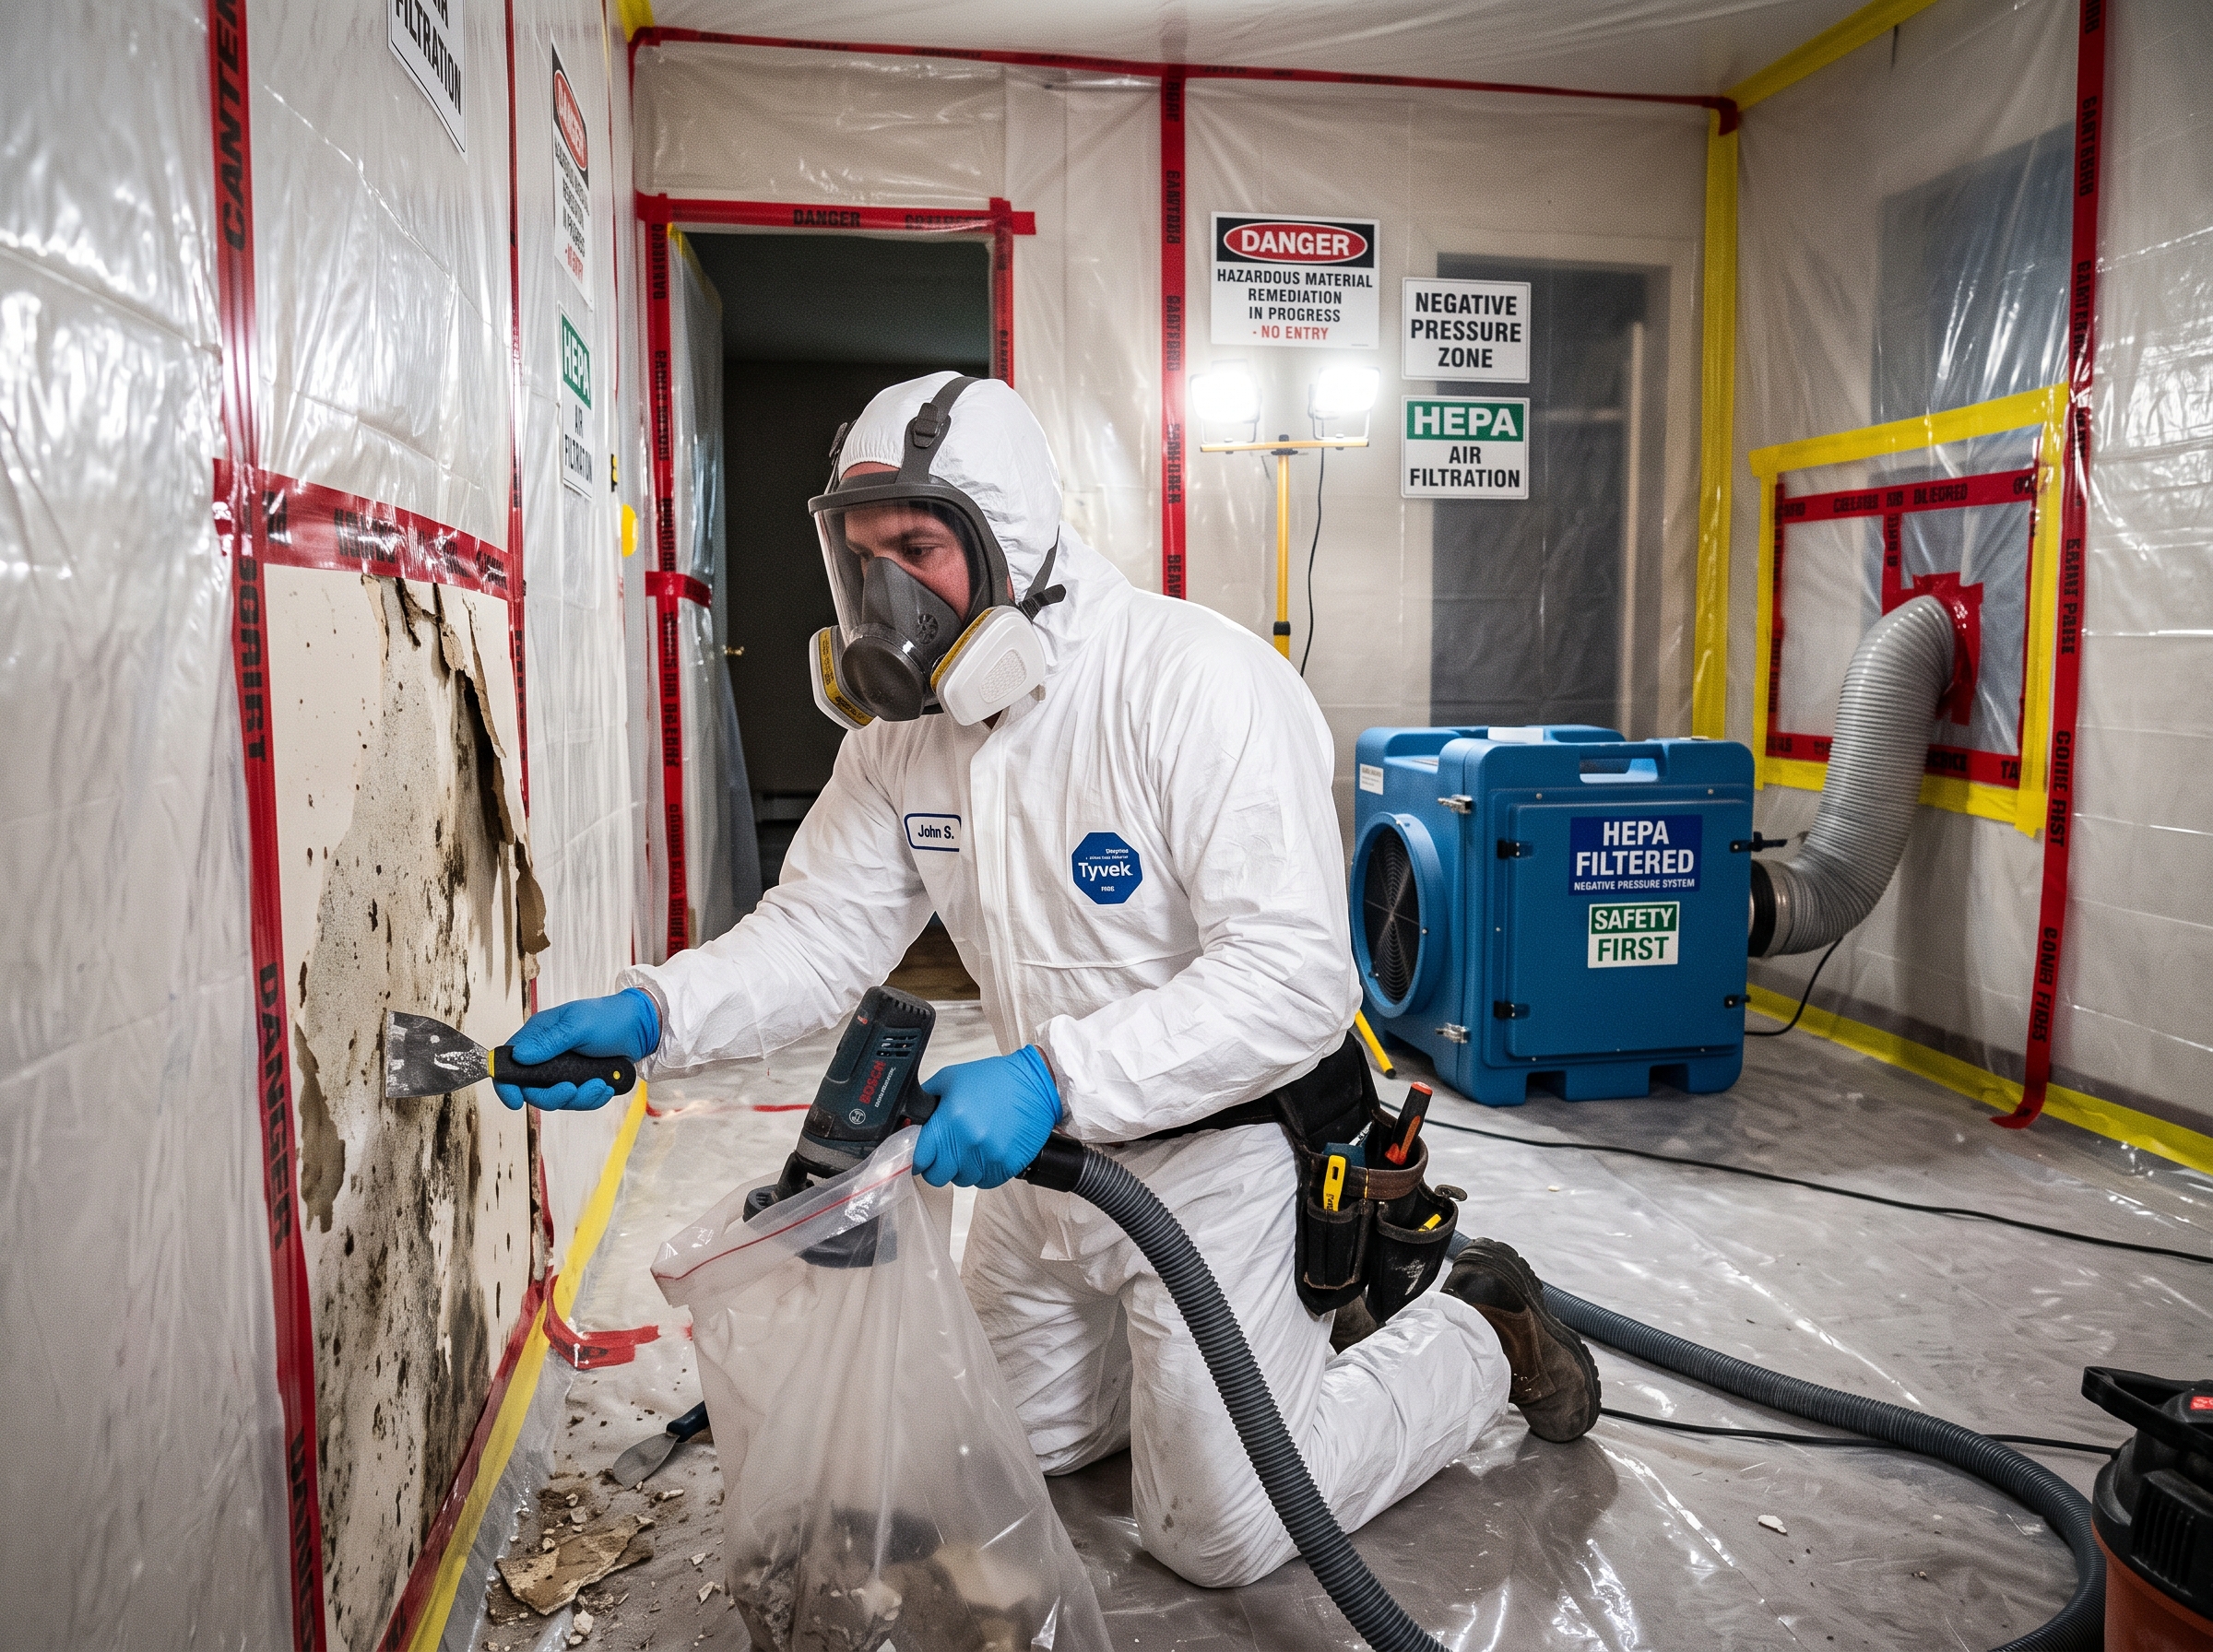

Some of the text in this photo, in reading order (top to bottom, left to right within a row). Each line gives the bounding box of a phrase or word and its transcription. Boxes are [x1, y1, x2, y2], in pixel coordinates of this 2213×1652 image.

[792, 208, 861, 229] DANGER
[1241, 230, 1350, 256] DANGER
[1217, 269, 1373, 288] HAZARDOUS MATERIAL
[1249, 289, 1342, 304] REMEDIATION
[1415, 292, 1517, 315] NEGATIVE
[1249, 306, 1341, 323] IN PROGRESS
[1261, 325, 1280, 339] NO
[1285, 325, 1329, 340] ENTRY
[1411, 319, 1521, 343] PRESSURE
[563, 325, 590, 401] HEPA
[1438, 347, 1493, 368] ZONE
[575, 404, 584, 440] AIR
[1414, 406, 1518, 436] HEPA
[1449, 446, 1481, 464] AIR
[1410, 468, 1520, 488] FILTRATION
[918, 824, 954, 839] John S.
[1604, 820, 1669, 846] HEPA
[1078, 861, 1133, 881] Tyvek
[1576, 849, 1694, 876] FILTERED
[1574, 879, 1695, 891] NEGATIVE PRESSURE SYSTEM
[1594, 908, 1674, 930] SAFETY
[1598, 937, 1669, 962] FIRST
[858, 1059, 886, 1104] BOSCH
[259, 962, 292, 1251] DANGER
